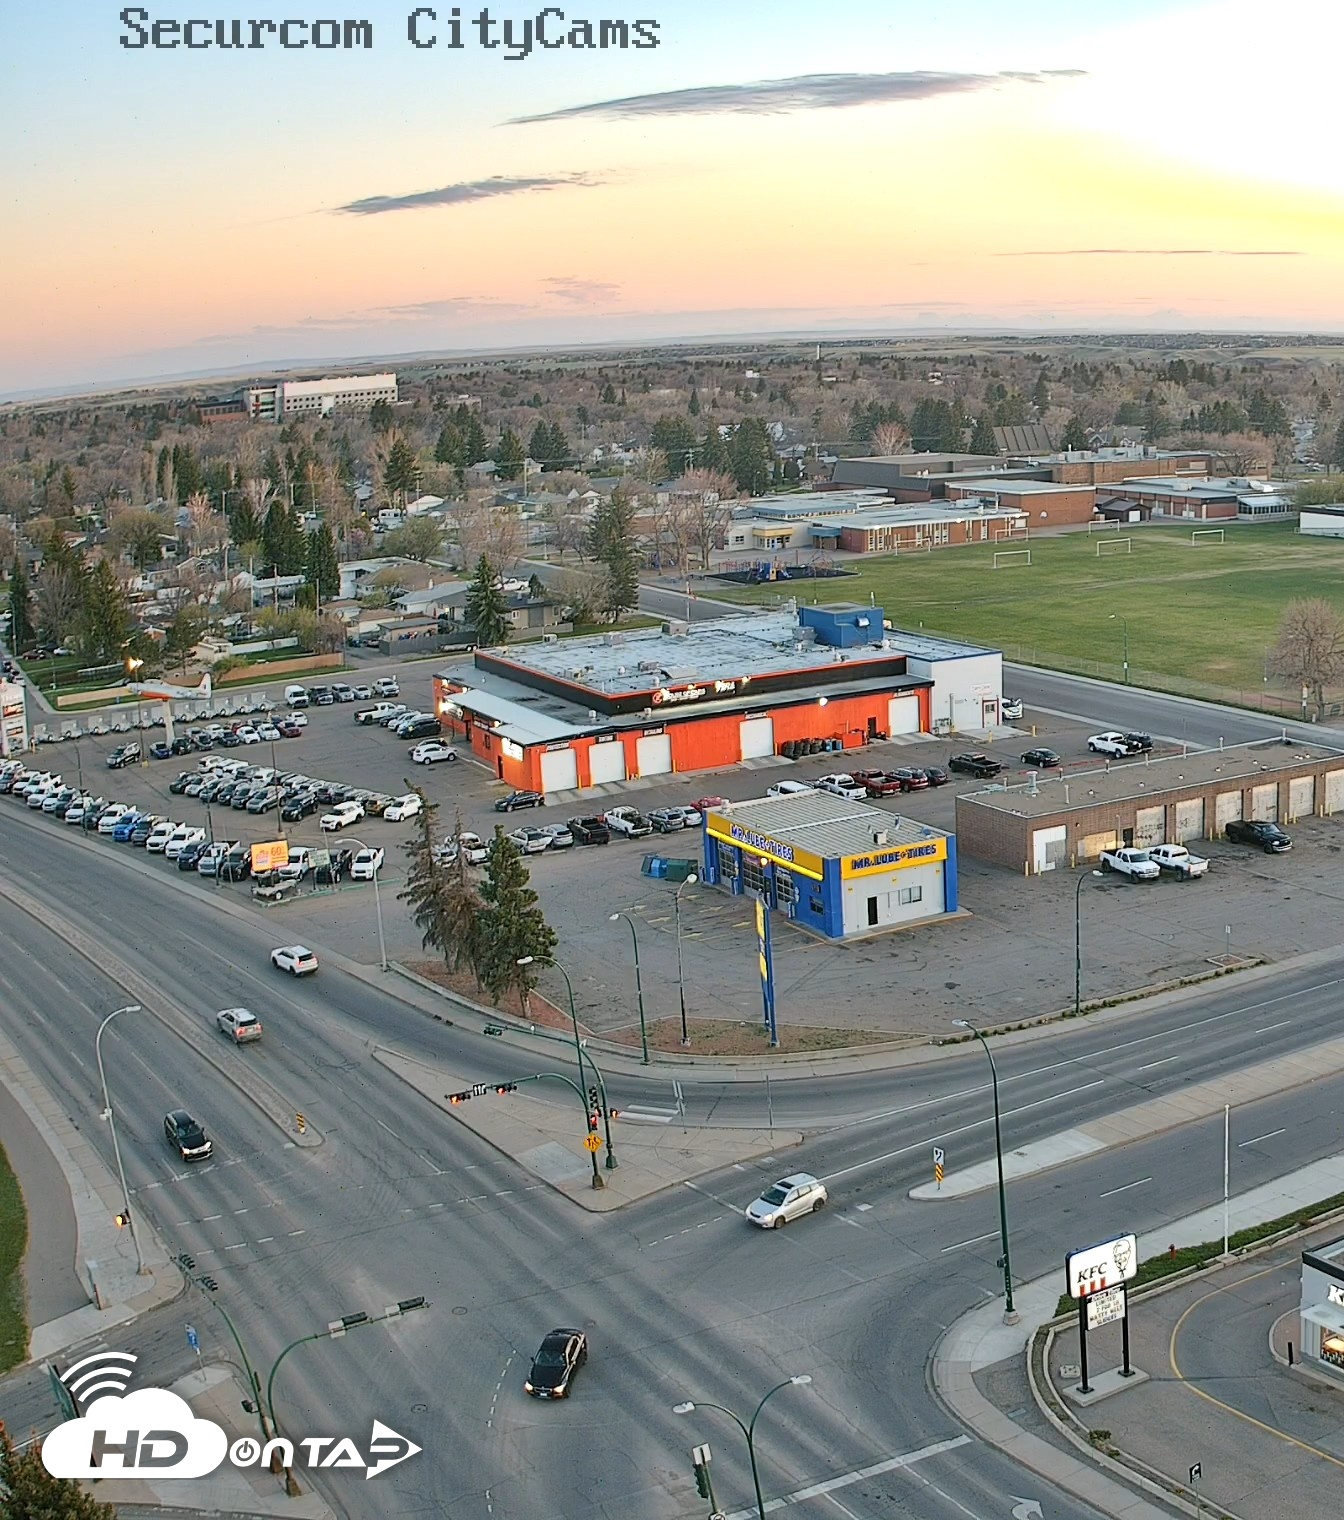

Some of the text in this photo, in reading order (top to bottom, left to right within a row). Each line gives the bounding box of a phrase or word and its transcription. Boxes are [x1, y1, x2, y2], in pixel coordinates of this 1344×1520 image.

[770, 840, 794, 862] TIRES
[907, 844, 937, 859] TIRES
[1077, 1262, 1107, 1284] KFC
